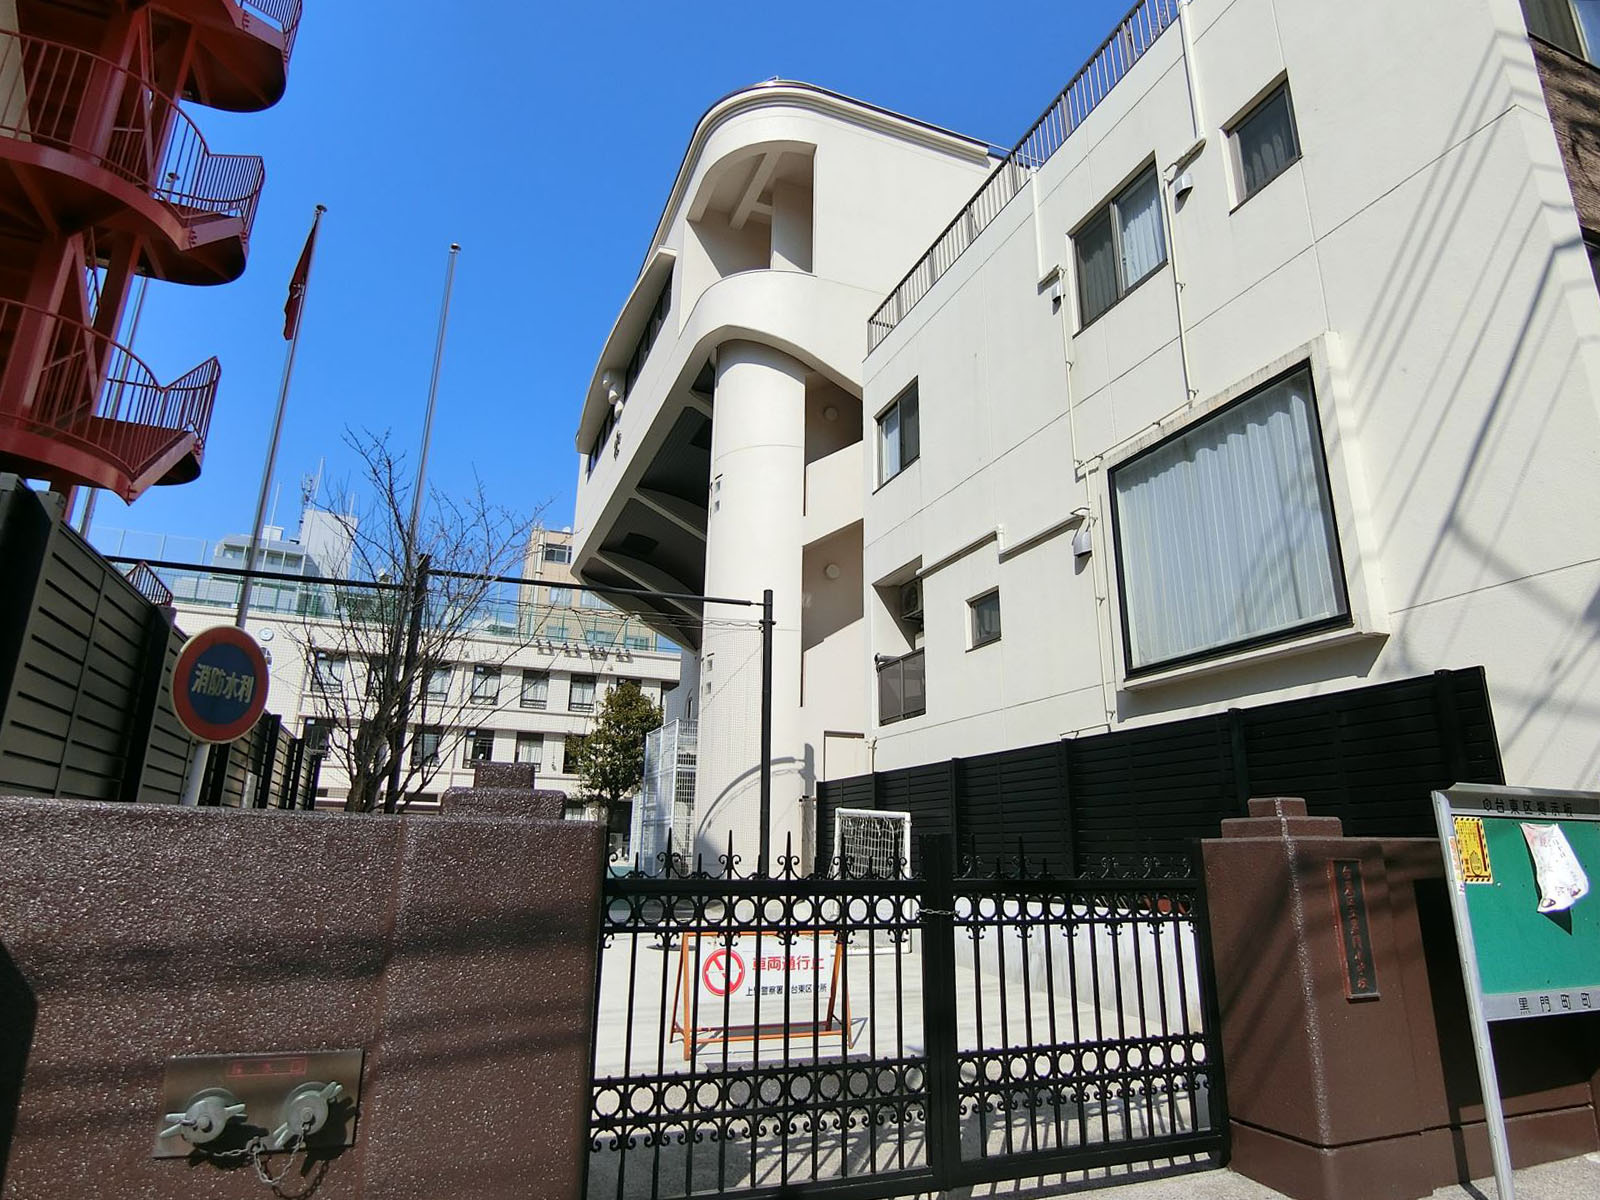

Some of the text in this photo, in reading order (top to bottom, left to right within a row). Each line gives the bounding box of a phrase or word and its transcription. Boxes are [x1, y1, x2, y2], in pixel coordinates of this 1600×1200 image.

[192, 663, 254, 703] 消防水利
[746, 983, 827, 997] 上警察署 台東区所
